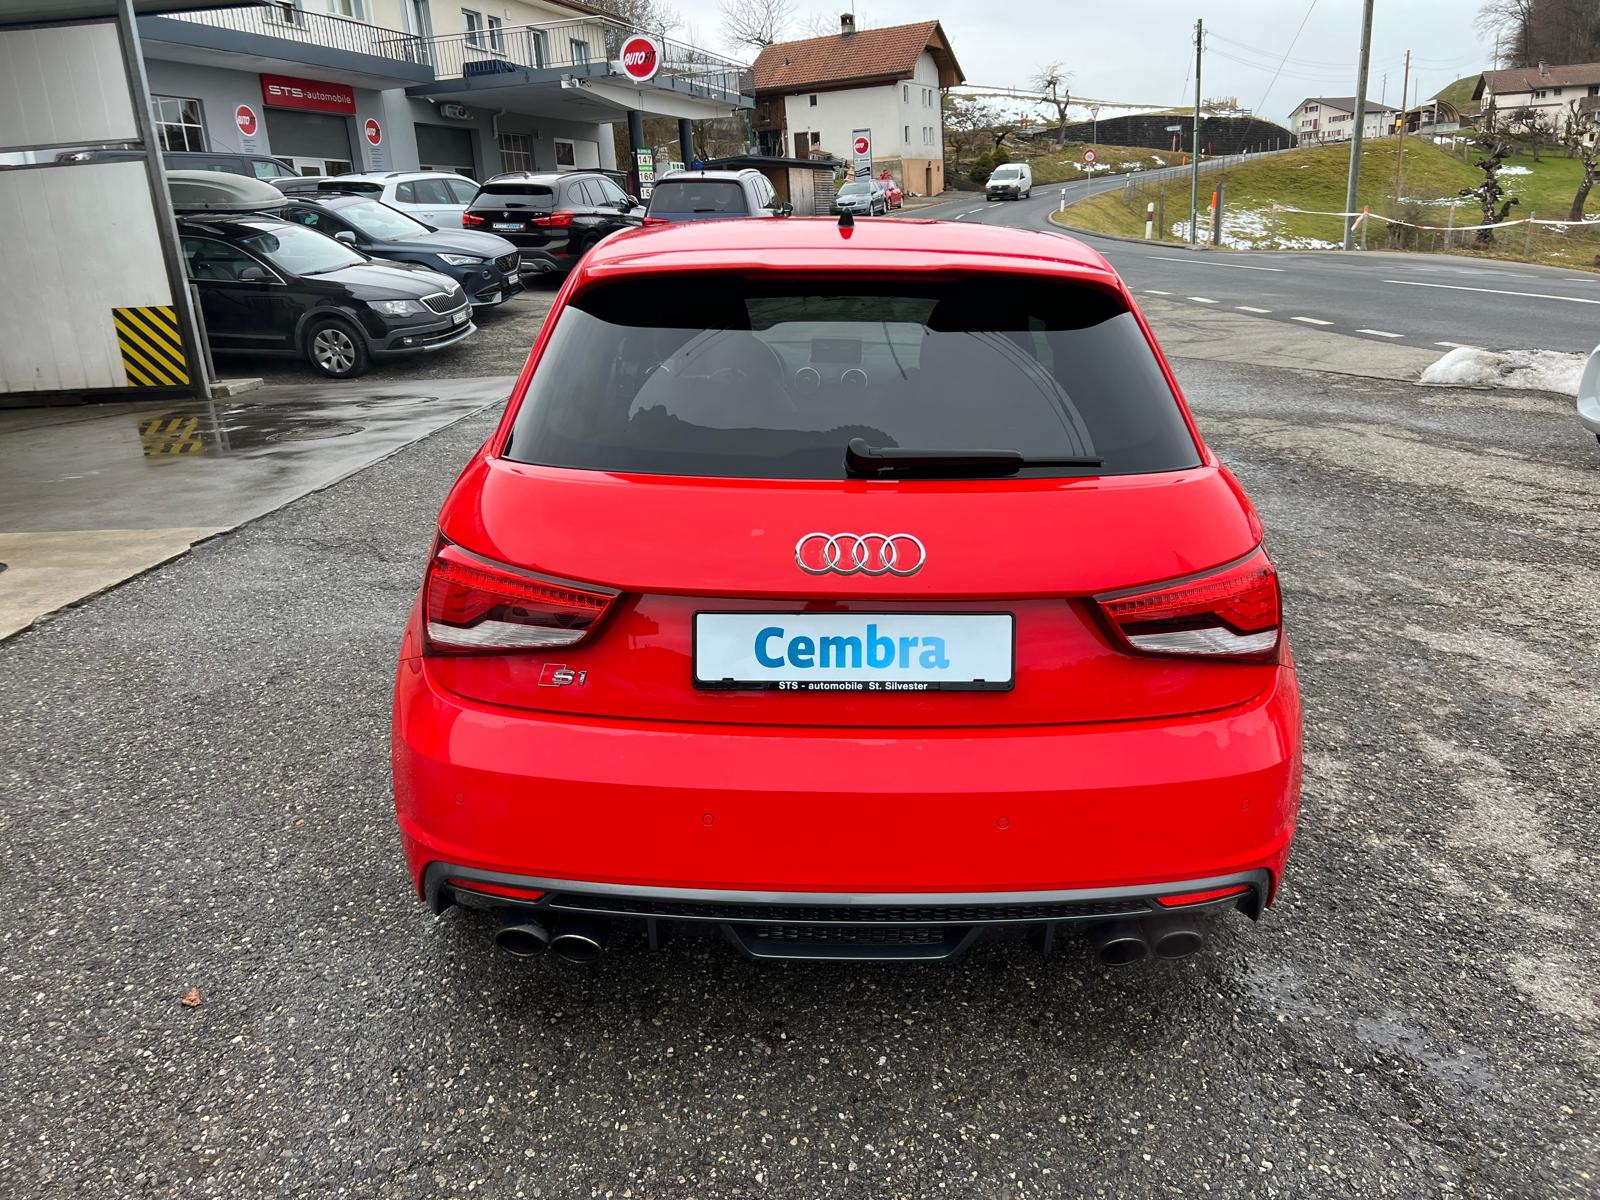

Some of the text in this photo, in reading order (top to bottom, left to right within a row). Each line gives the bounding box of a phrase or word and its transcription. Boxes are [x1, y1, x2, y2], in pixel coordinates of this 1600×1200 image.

[639, 155, 652, 164] 147
[640, 173, 653, 181] 160
[755, 624, 950, 669] Cembra
[552, 669, 588, 686] S1
[778, 681, 799, 690] STS
[808, 681, 863, 690] automobile
[868, 681, 882, 690] St.
[885, 681, 928, 690] Silvester
